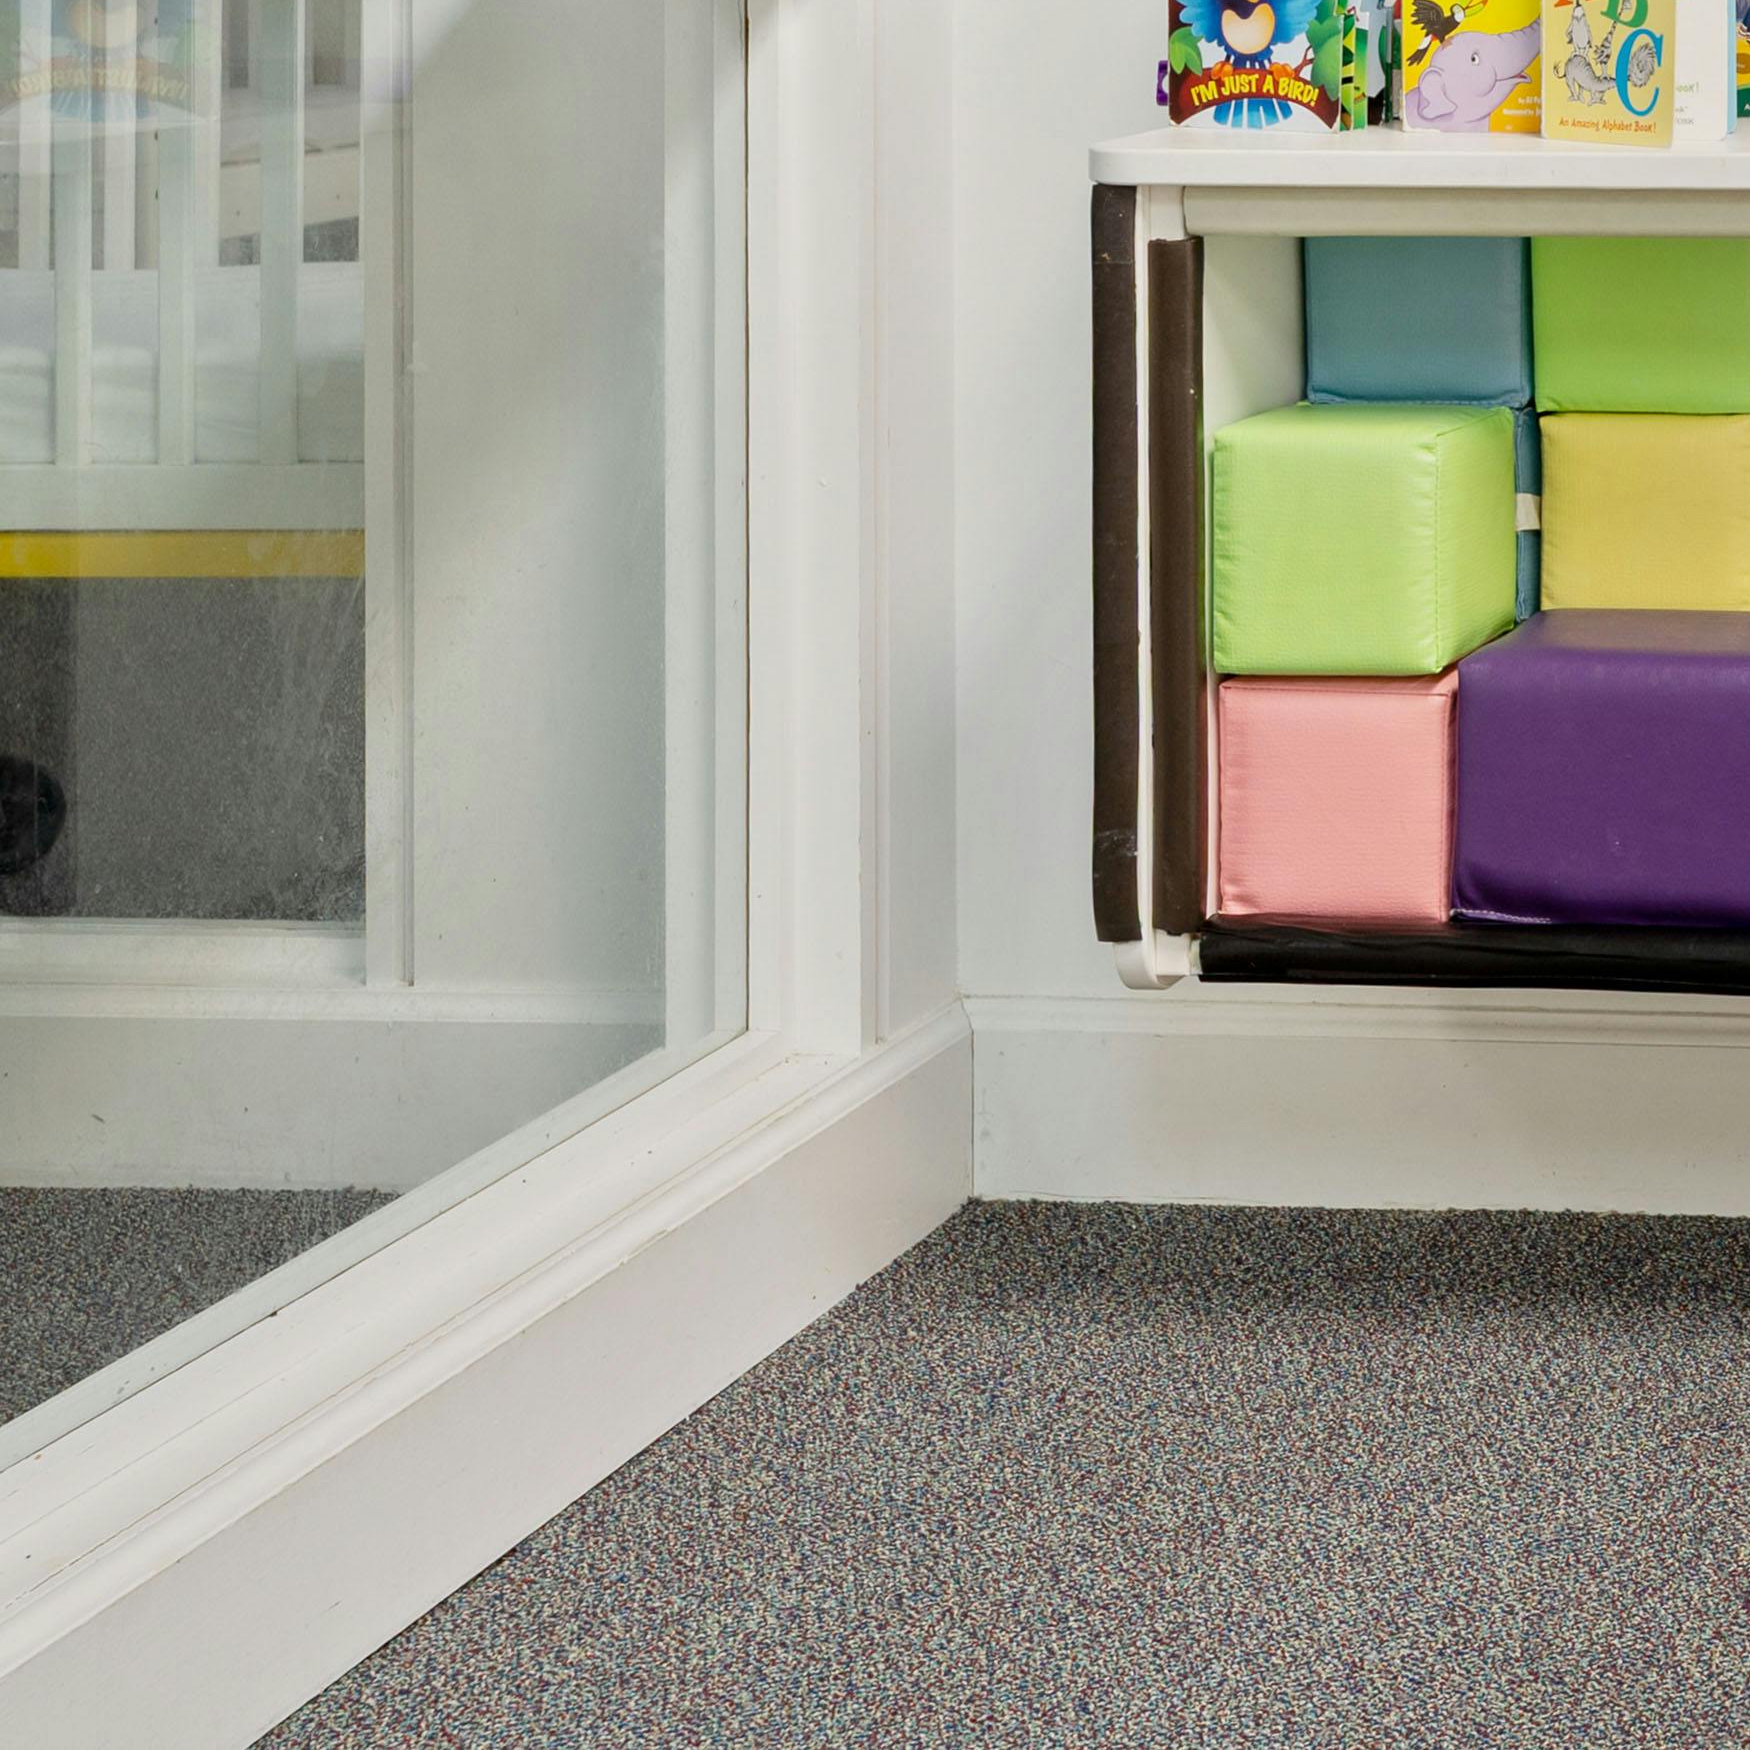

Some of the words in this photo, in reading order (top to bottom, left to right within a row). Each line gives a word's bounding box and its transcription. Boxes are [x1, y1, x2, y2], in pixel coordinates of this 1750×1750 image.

[1190, 80, 1219, 107] I'M
[1220, 73, 1260, 97] JUST
[1263, 74, 1275, 95] A
[1278, 77, 1320, 108] BIRD!
[1559, 117, 1569, 127] An
[1571, 118, 1601, 132] Amazing
[1602, 119, 1633, 133] Alphabet
